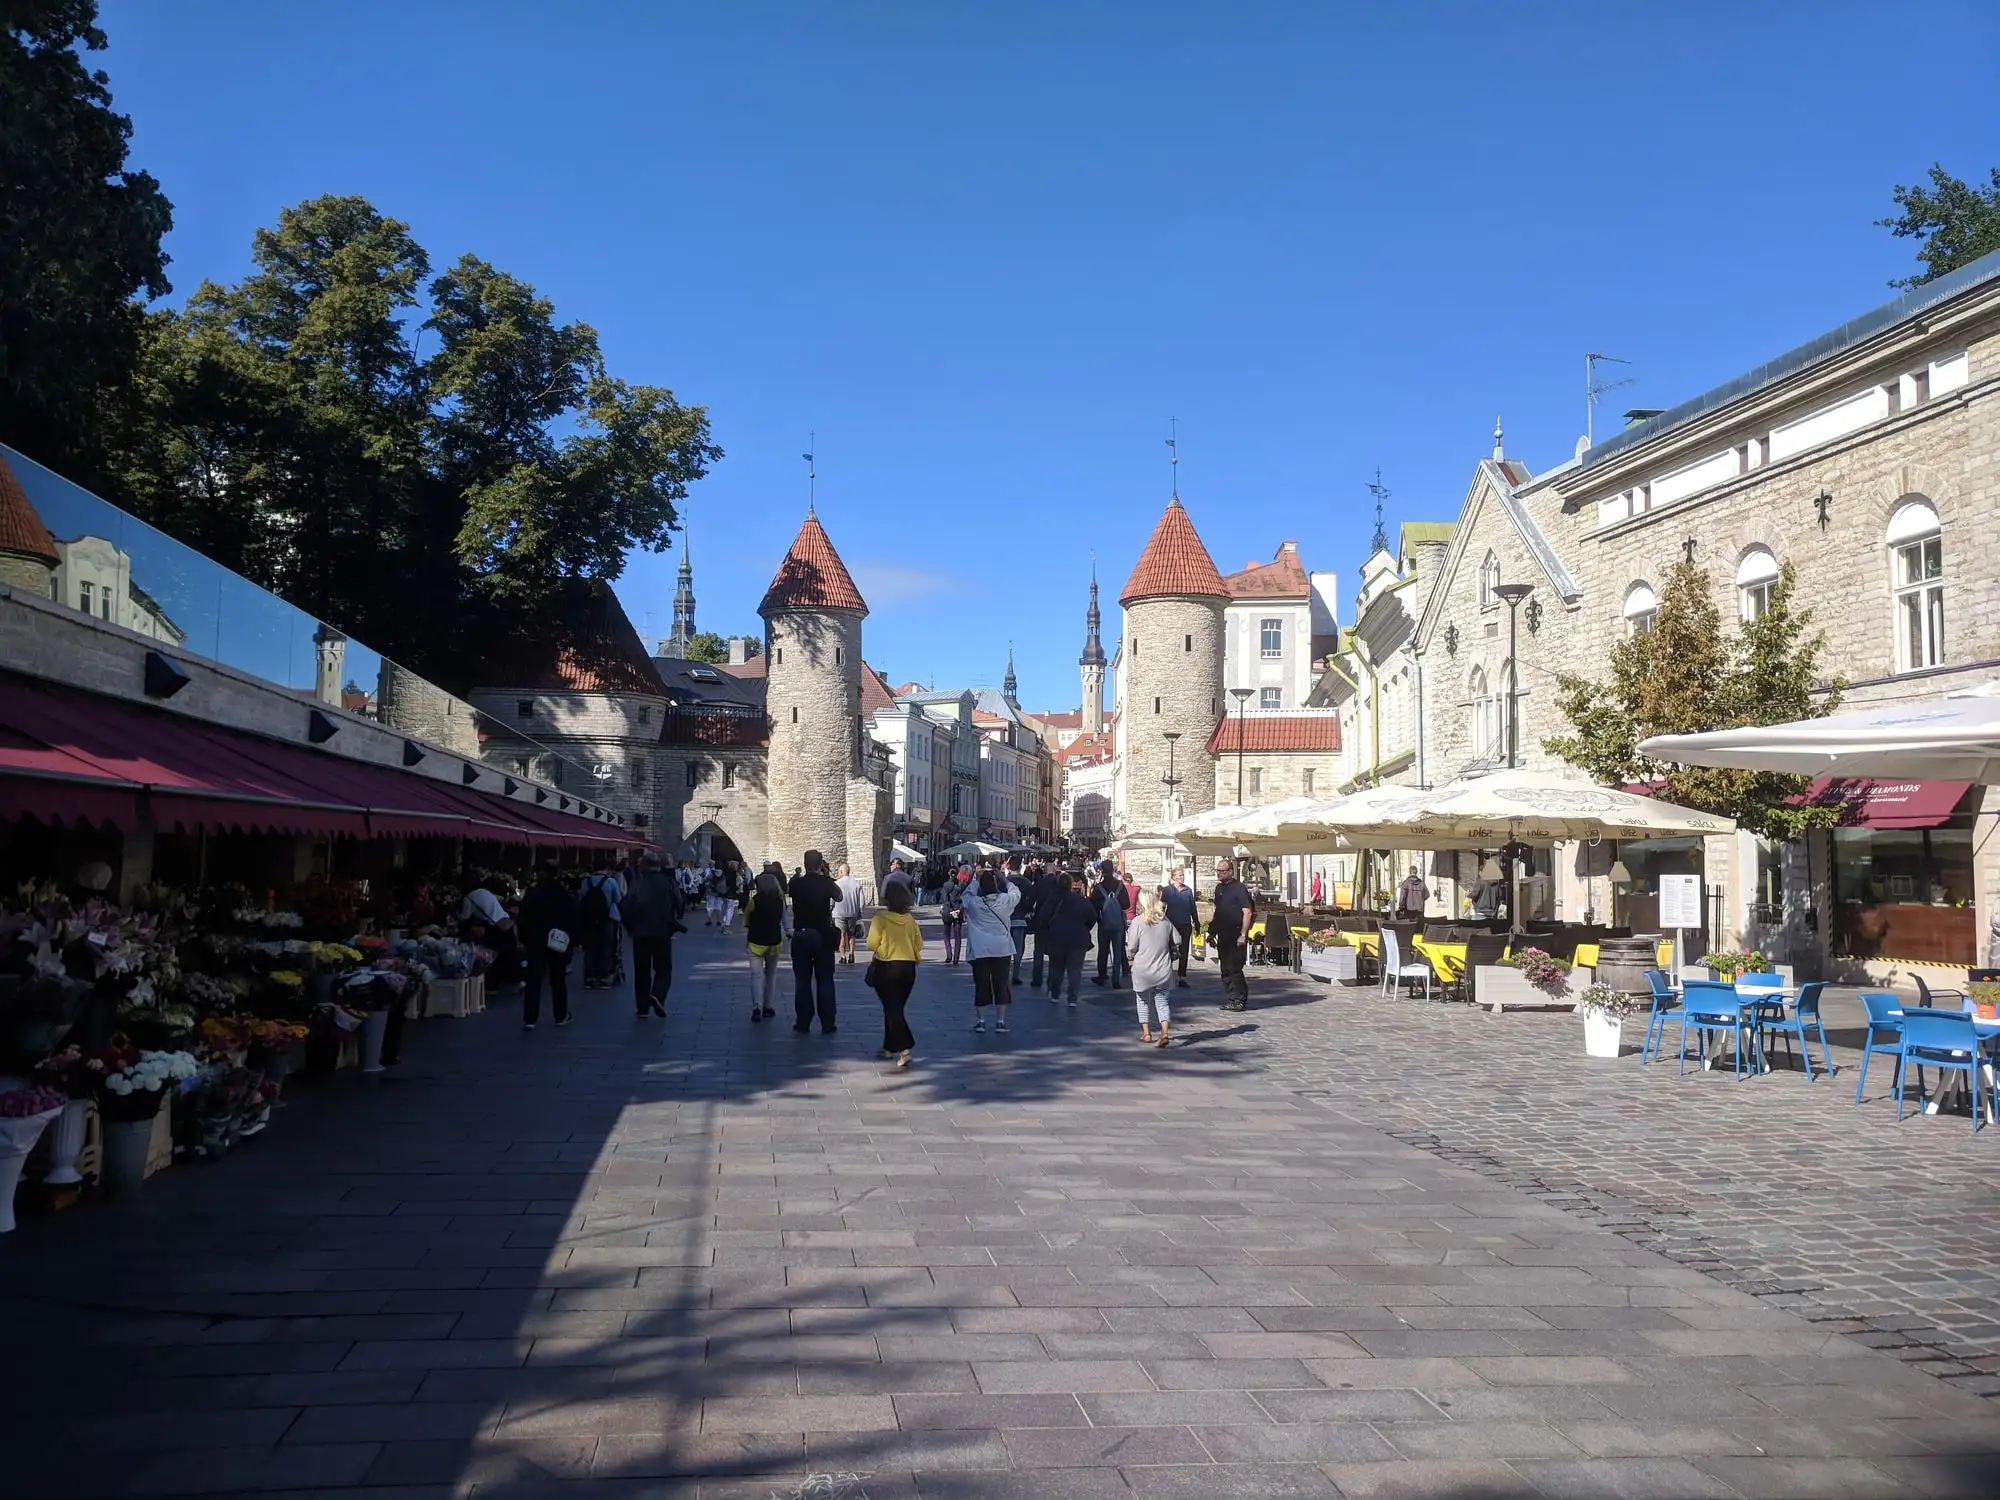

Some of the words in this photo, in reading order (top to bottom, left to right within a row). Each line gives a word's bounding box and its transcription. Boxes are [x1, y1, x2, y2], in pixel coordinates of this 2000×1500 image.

[1854, 787, 1862, 795] &
[1864, 784, 1921, 794] DIAMONDS
[1686, 819, 1716, 829] saku
